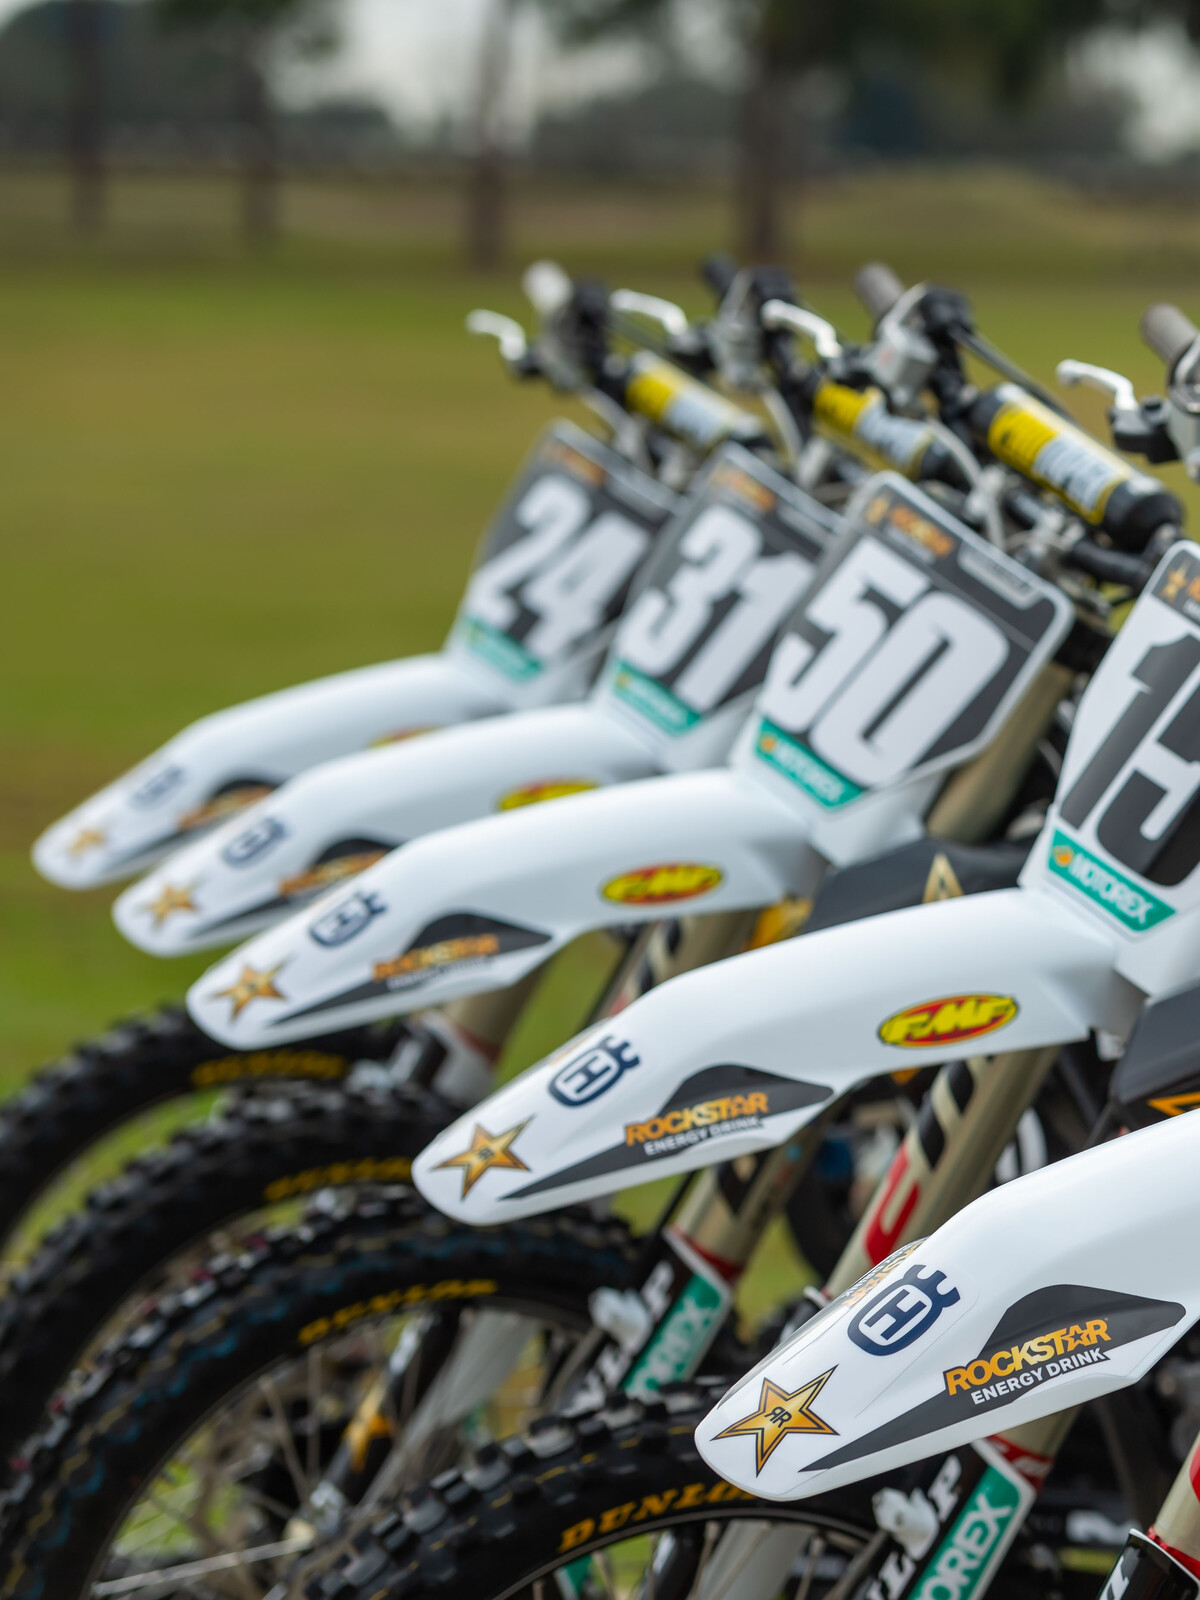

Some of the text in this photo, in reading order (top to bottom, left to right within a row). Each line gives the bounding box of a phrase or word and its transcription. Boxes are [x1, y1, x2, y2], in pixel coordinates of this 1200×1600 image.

[469, 475, 651, 660] 24
[617, 505, 818, 710] 31
[765, 537, 1008, 786] 50
[1068, 852, 1154, 924] MOTOREX
[884, 995, 1013, 1043] FMF
[625, 1091, 769, 1147] ROCKSTAR
[644, 1115, 759, 1156] ENERGY DRINK
[945, 1319, 1112, 1396] ROCKSTAR
[970, 1347, 1108, 1405] ENERGY DRINK
